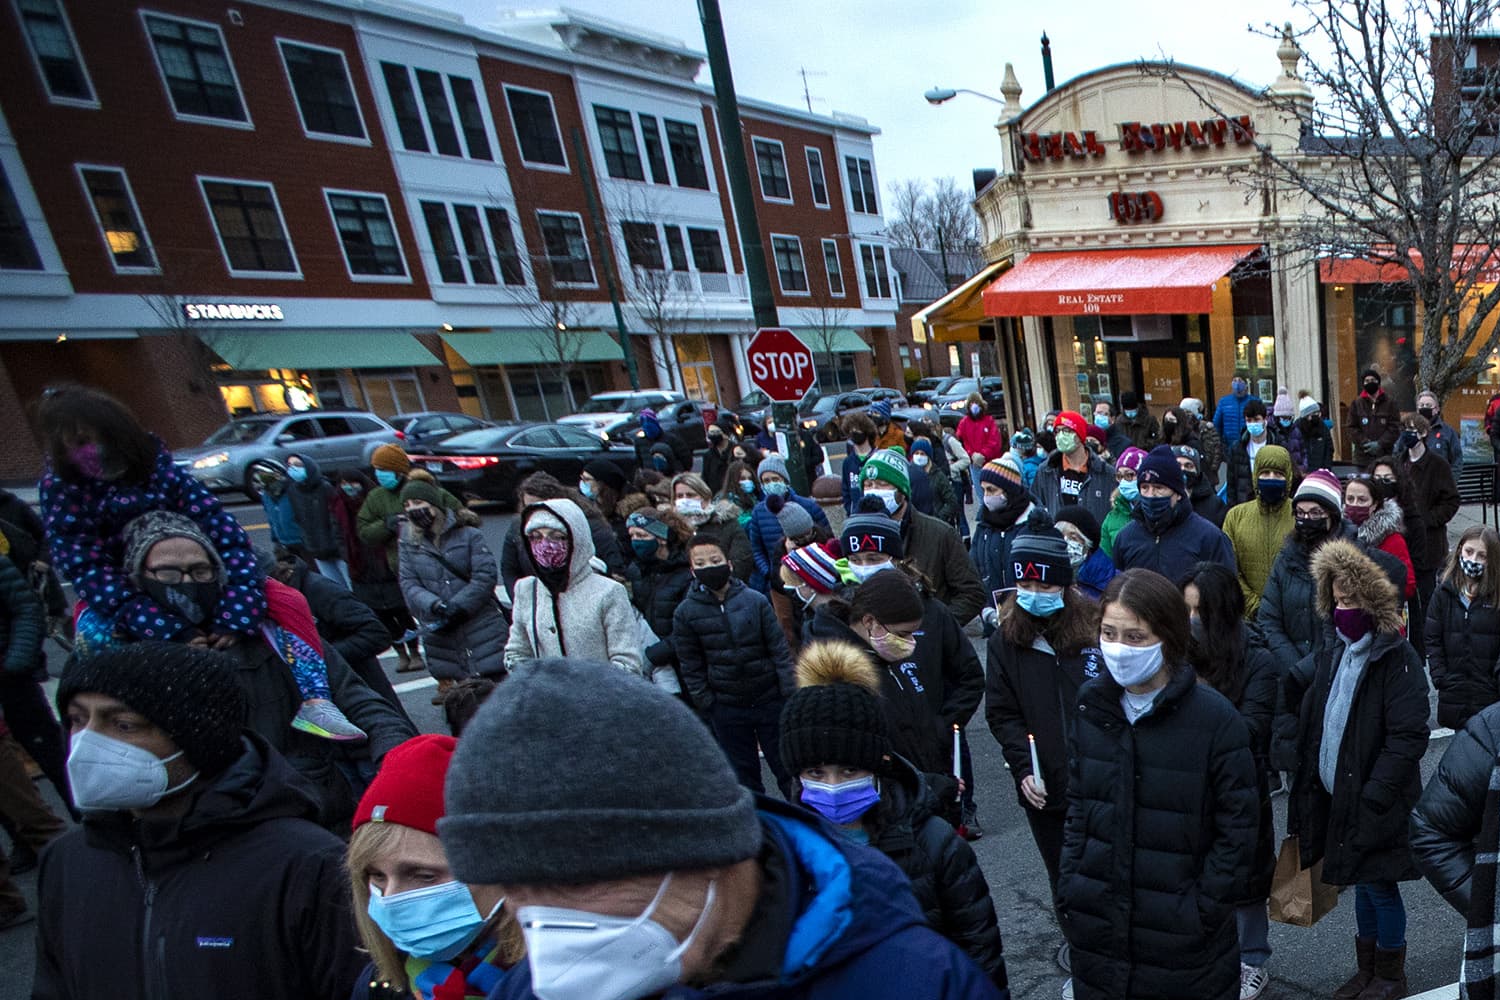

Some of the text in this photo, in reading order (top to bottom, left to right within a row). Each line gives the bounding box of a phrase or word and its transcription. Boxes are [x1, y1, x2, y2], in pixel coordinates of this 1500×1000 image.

[1058, 294, 1124, 304] REAL ESTATE
[185, 304, 285, 320] STARBUCKS
[752, 351, 809, 381] STOP
